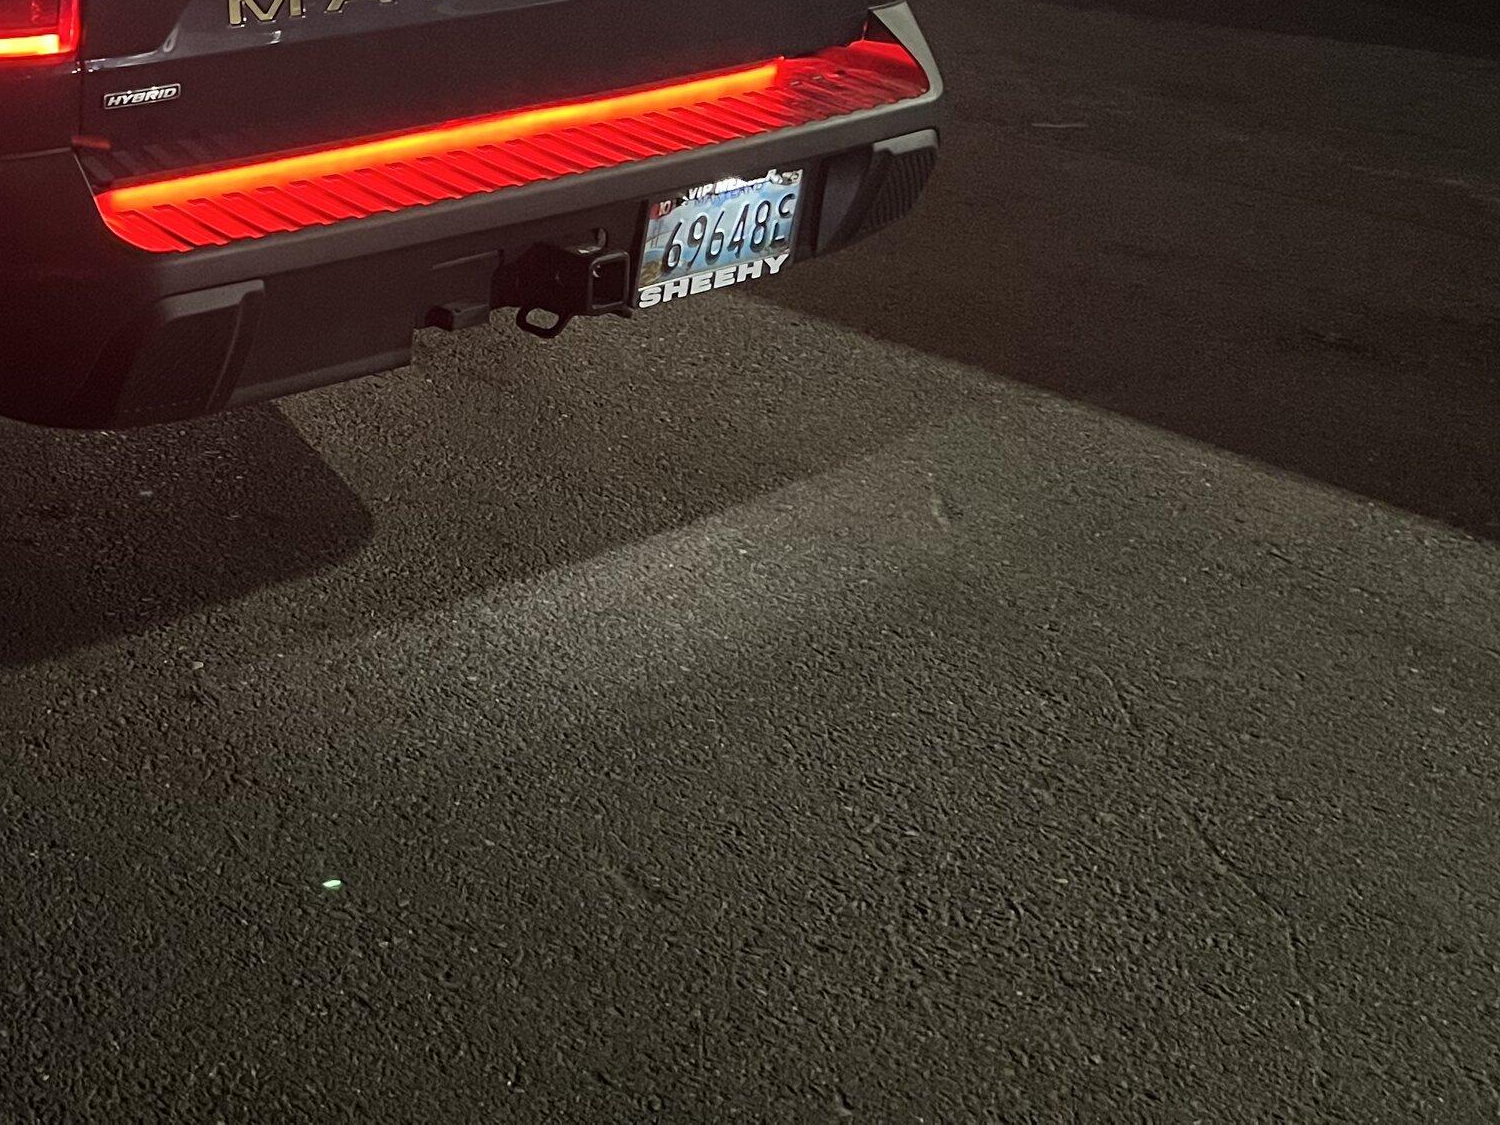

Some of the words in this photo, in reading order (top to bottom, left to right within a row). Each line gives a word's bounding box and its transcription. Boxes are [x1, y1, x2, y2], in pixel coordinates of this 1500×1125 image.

[107, 87, 177, 106] HYBRID
[688, 183, 714, 200] VIP
[638, 253, 790, 309] SHEEHY
